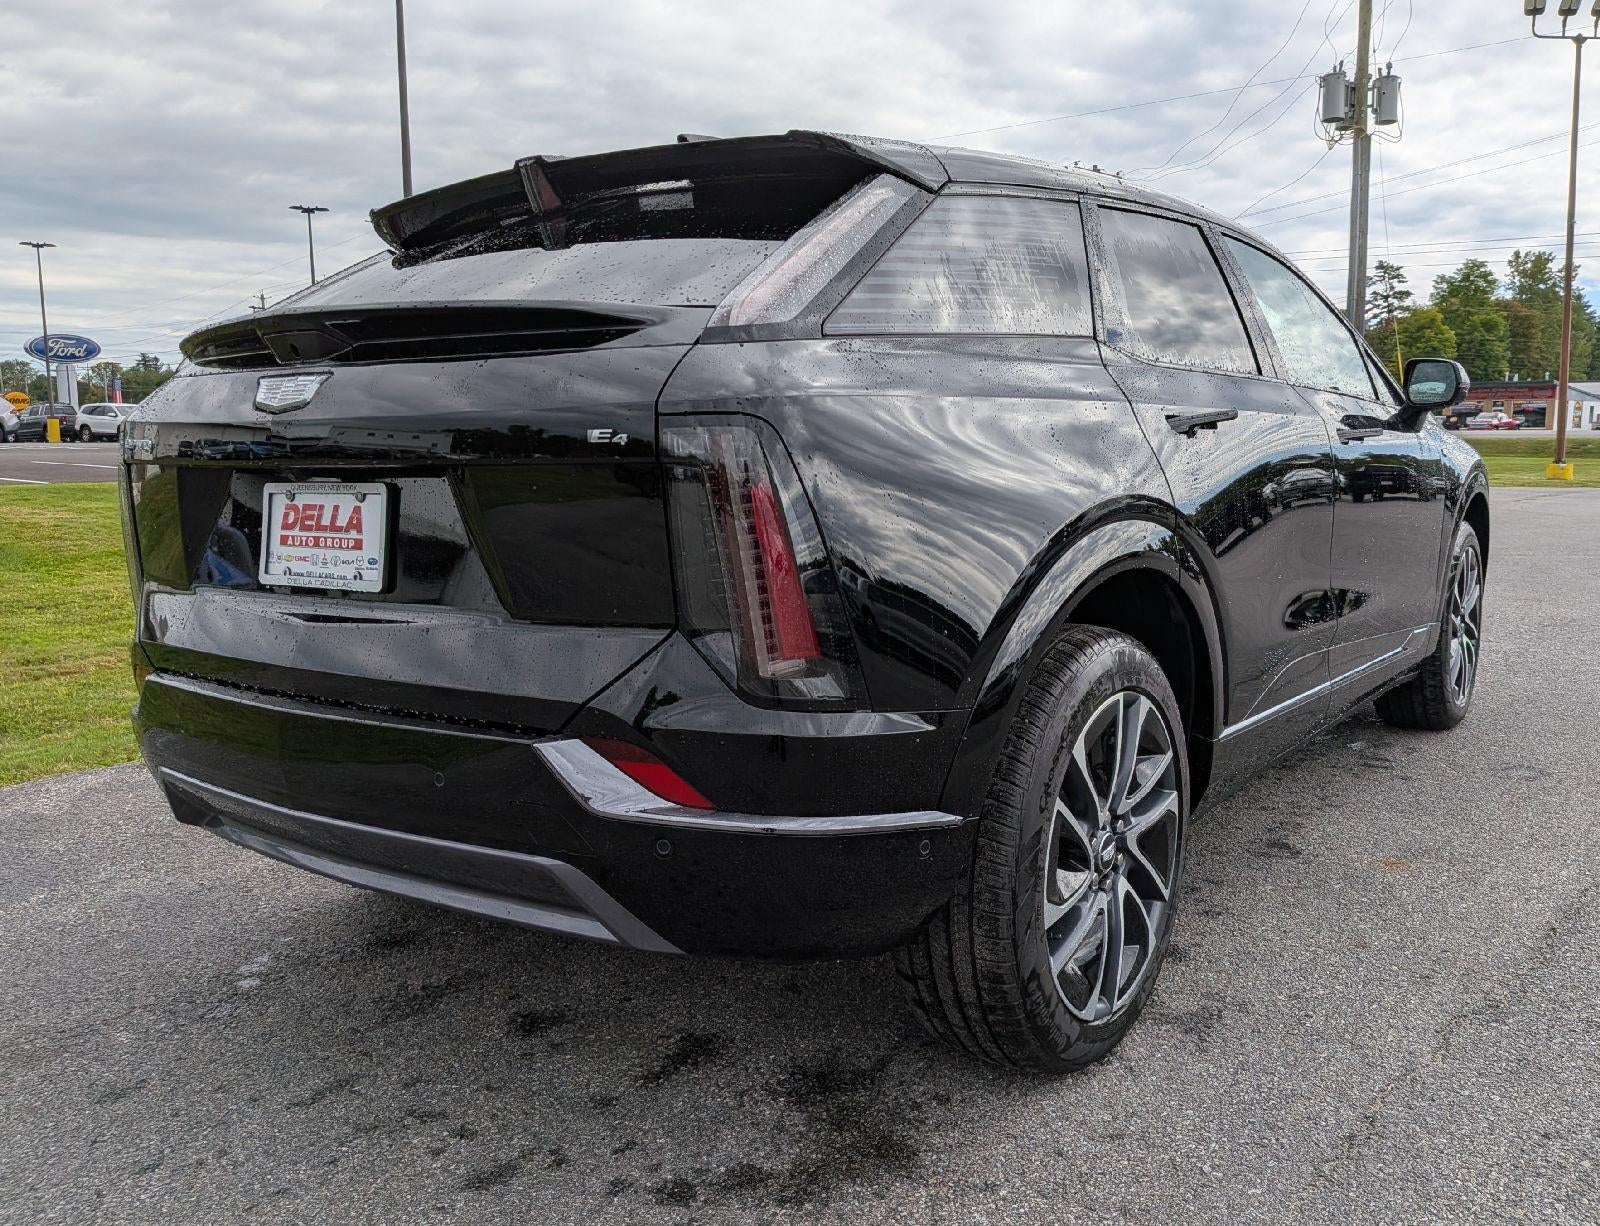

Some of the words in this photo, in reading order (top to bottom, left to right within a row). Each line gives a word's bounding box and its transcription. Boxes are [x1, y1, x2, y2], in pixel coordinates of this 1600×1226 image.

[48, 338, 88, 357] Ford
[587, 429, 628, 446] E4
[328, 483, 341, 491] NEW
[342, 483, 358, 491] YORK
[280, 503, 363, 534] DELLA
[287, 536, 315, 547] AUTO
[319, 537, 355, 549] GROUP
[315, 579, 353, 589] CADILLAC
